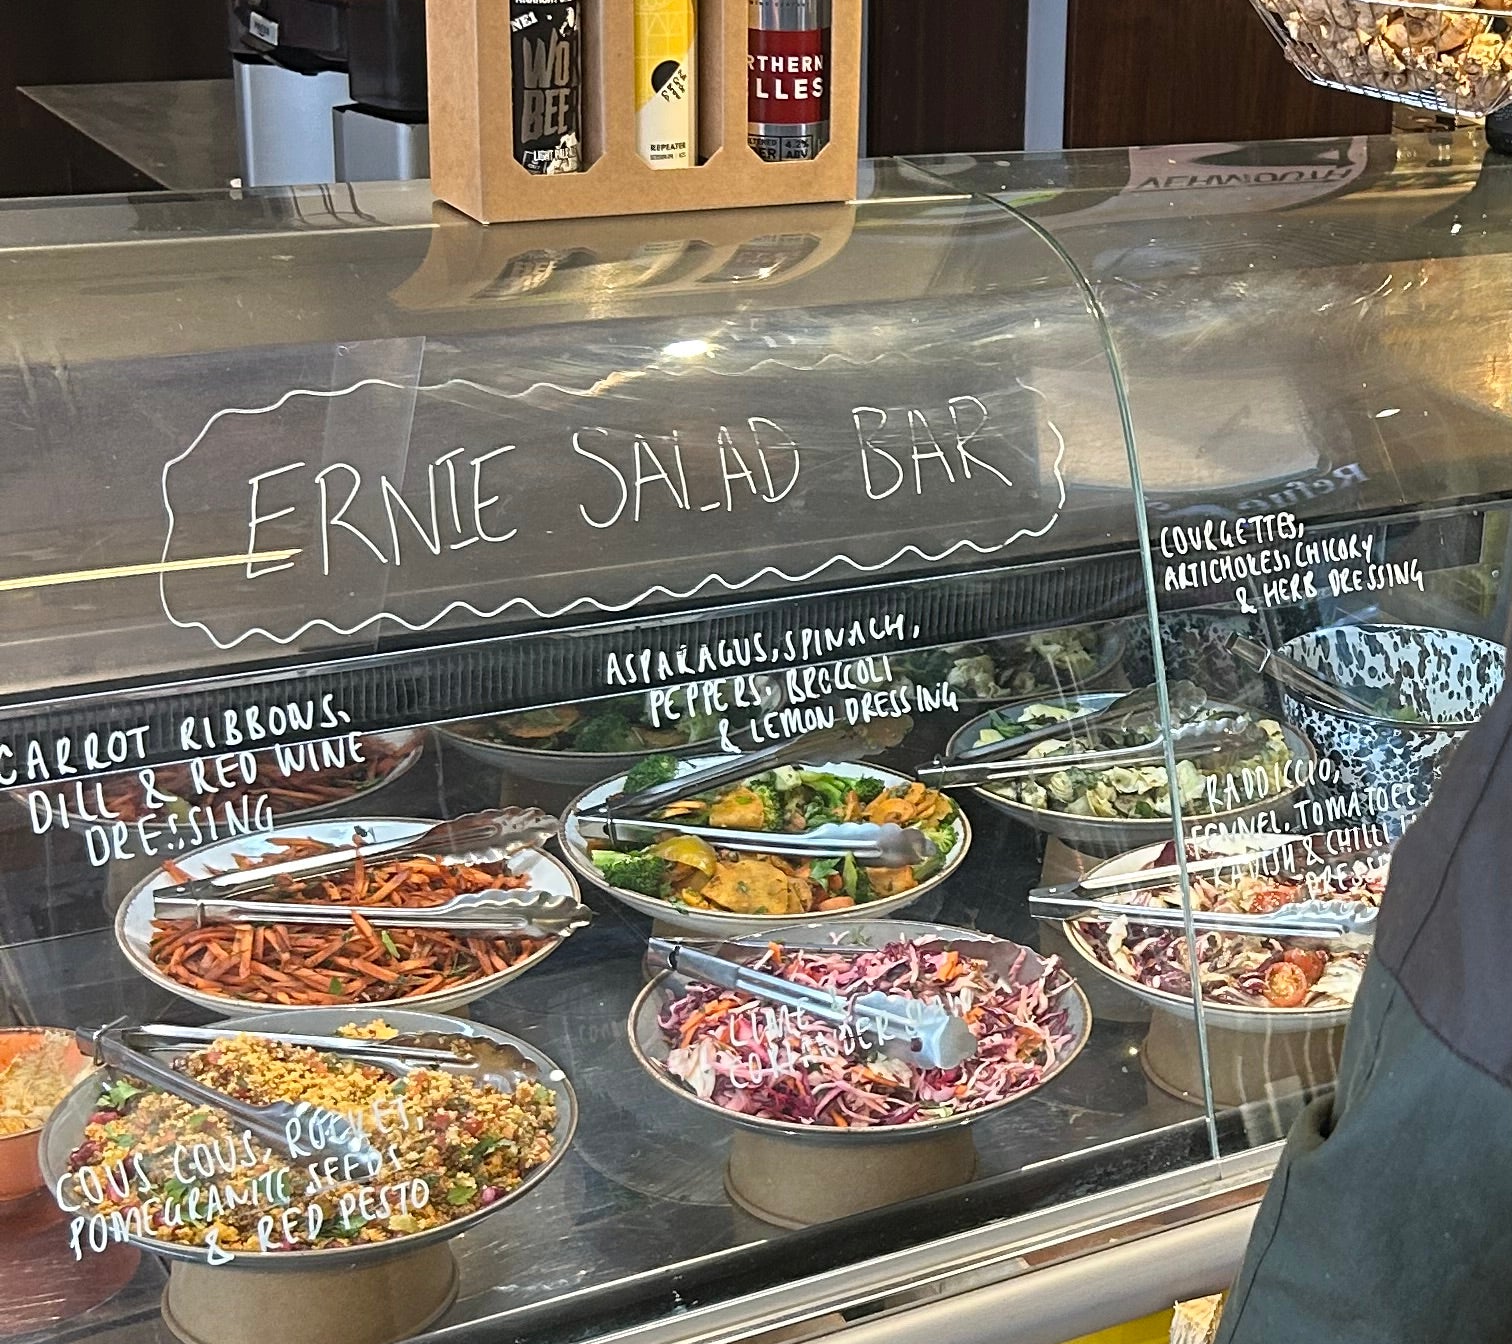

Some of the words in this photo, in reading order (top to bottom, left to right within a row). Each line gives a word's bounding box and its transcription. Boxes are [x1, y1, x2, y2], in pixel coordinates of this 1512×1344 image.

[522, 27, 572, 89] WO
[748, 55, 824, 73] RTHERN
[755, 76, 824, 100] LLES
[247, 445, 518, 580] ERNIE
[569, 416, 801, 531] SALAD
[851, 396, 1012, 502] BAR
[1296, 533, 1374, 570] CHICORY
[1235, 588, 1258, 615] &
[1263, 574, 1318, 609] HERB
[1331, 557, 1425, 598] DRESSING
[786, 656, 893, 705] BROCCOLI
[719, 719, 742, 754] &
[751, 704, 834, 743] LEMON
[849, 682, 960, 726] DRESSING
[0, 725, 150, 786] CARROT
[28, 780, 118, 834] DILL
[139, 769, 178, 808] &
[191, 751, 258, 795] RED
[276, 732, 367, 778] WINE
[85, 794, 275, 868] DRESSING
[1294, 783, 1418, 830] TOMATOES
[1302, 835, 1325, 867] &
[56, 1154, 153, 1214] COUS
[306, 1144, 404, 1194] SEEDS
[205, 1229, 235, 1267] &
[257, 1205, 324, 1252] RED
[340, 1177, 430, 1232] PESTO
